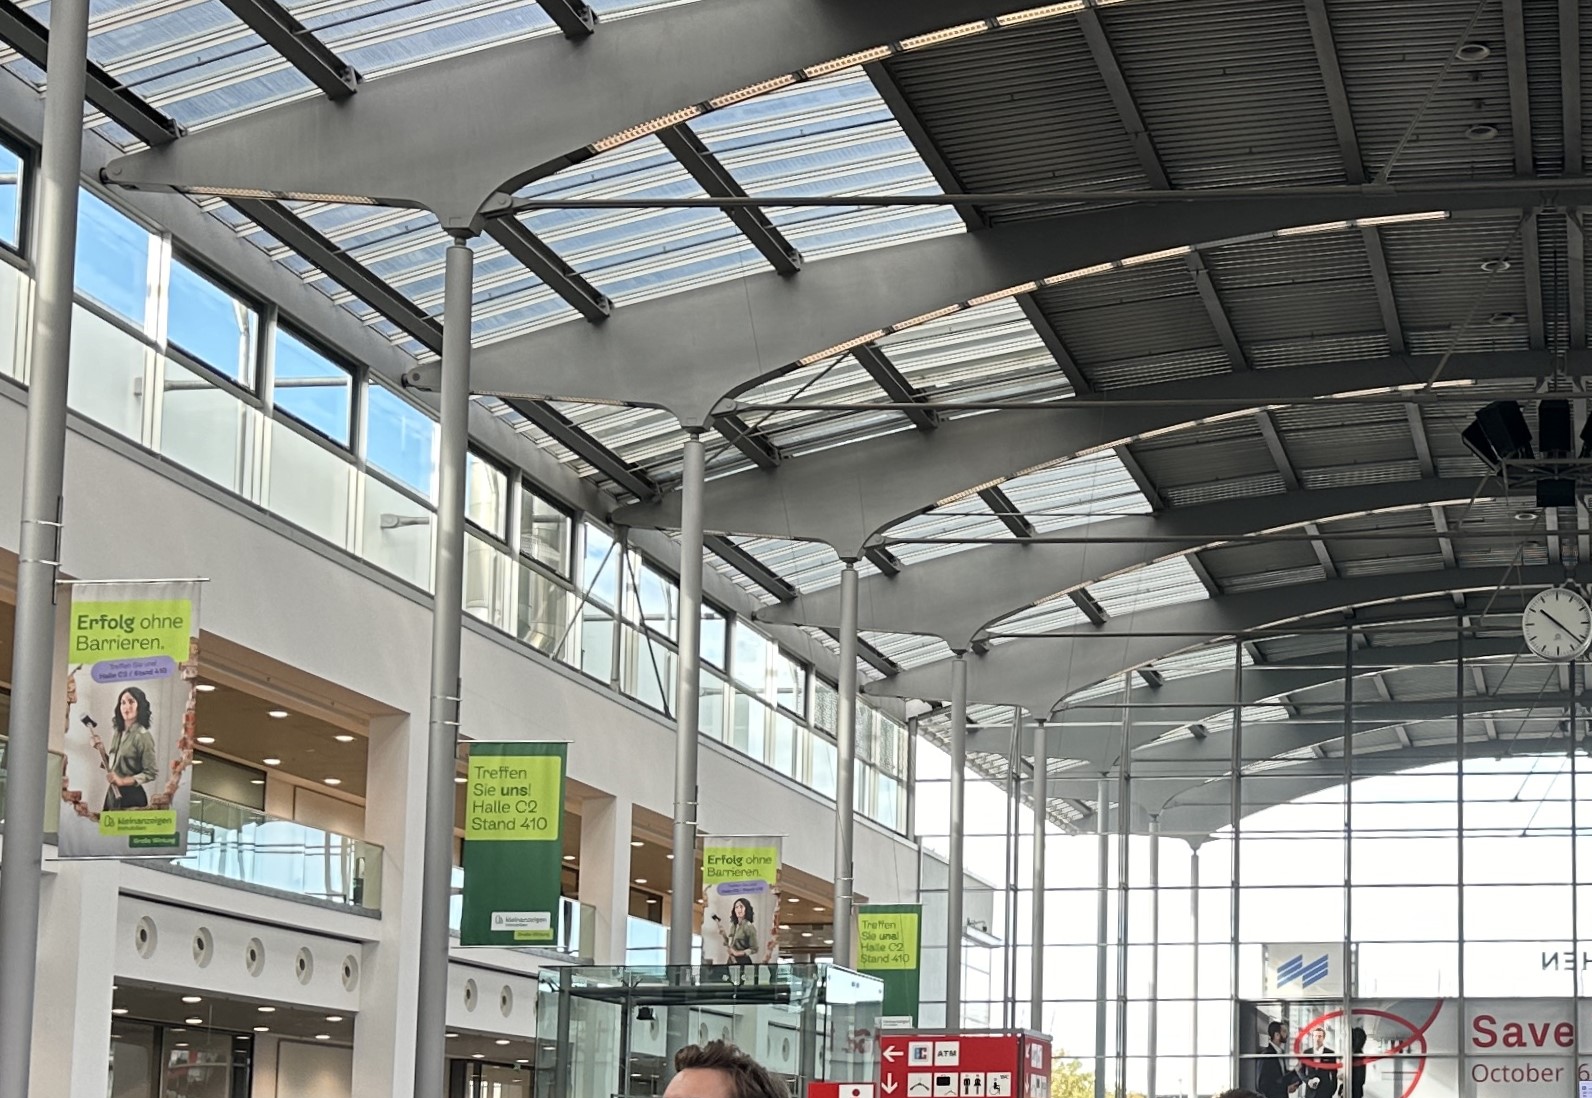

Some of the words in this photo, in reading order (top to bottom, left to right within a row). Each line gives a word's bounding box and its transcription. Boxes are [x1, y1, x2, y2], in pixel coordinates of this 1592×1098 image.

[77, 614, 135, 633] Erfolg
[140, 614, 183, 629] ohne
[76, 635, 165, 651] Barrieren.
[474, 766, 527, 779] Treffen
[473, 783, 496, 796] Sie
[501, 783, 532, 797] uns!
[473, 800, 511, 813] Halle
[515, 800, 538, 813] C2
[472, 817, 516, 831] Stand
[520, 817, 548, 831] 410
[707, 854, 743, 867] Erfolg
[745, 854, 772, 865] ohne
[707, 867, 760, 877] Barrieren.
[862, 920, 896, 929] Treffen
[862, 932, 876, 941] Sie
[861, 943, 885, 952] Halle
[888, 943, 904, 952] C2
[861, 954, 889, 963] Stand
[891, 954, 910, 963] 410
[1472, 1015, 1574, 1047] Save
[1471, 1063, 1564, 1082] October
